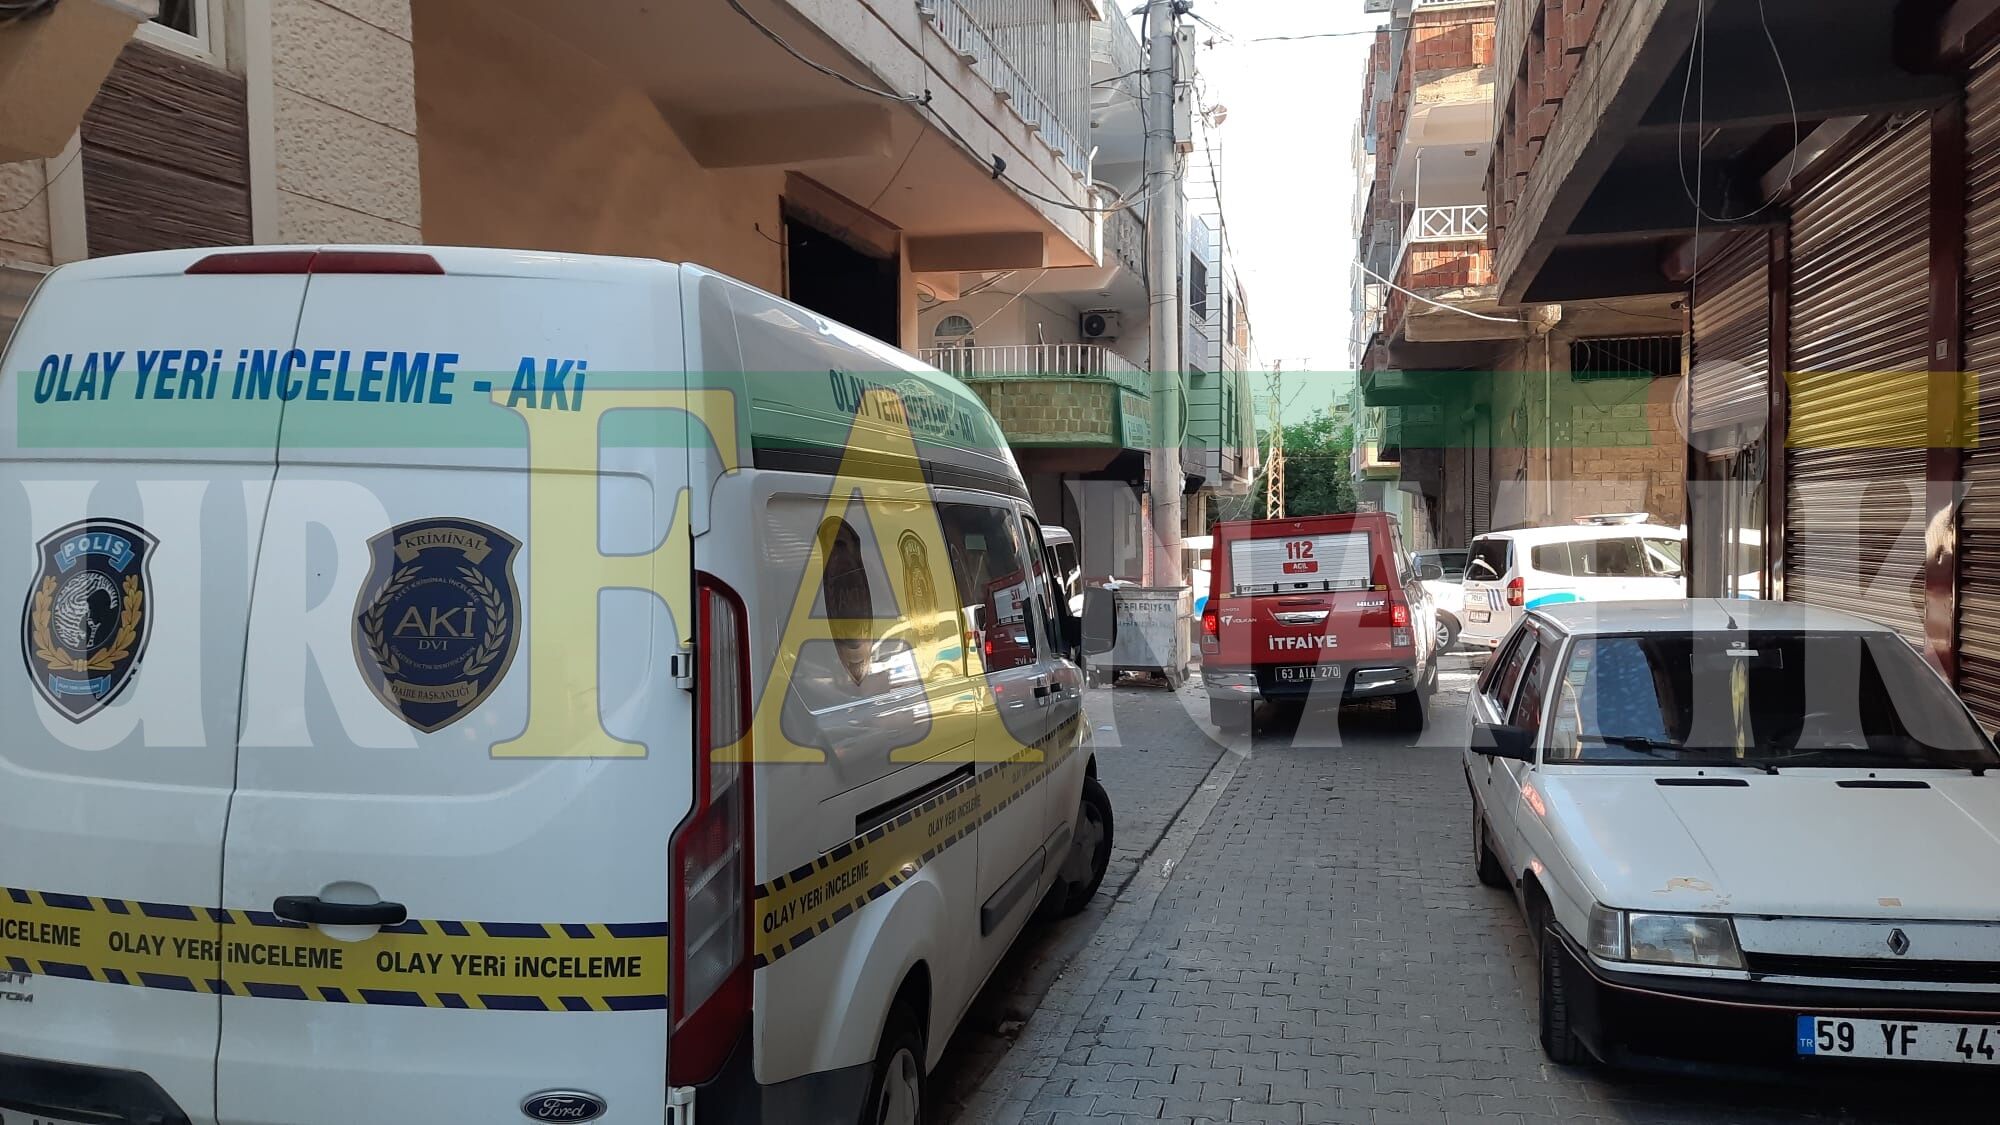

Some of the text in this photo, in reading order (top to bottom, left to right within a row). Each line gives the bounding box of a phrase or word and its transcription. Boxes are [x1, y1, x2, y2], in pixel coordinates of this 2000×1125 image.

[34, 351, 125, 404] OLAY
[830, 369, 869, 416] OLAY
[405, 532, 482, 550] KRİMİNAL
[1286, 541, 1313, 559] 112
[393, 602, 476, 637] AKİ
[418, 640, 448, 651] DVI
[1268, 633, 1338, 650] İTFAİYE
[1281, 668, 1294, 679] 63
[1321, 666, 1339, 678] 270
[763, 899, 797, 934] OLAY
[108, 930, 166, 956] OLAY
[376, 951, 443, 974] OLAY
[1800, 1038, 1814, 1048] TR
[1817, 1020, 2000, 1060] 59 YF 44
[538, 1098, 586, 1117] Ford
